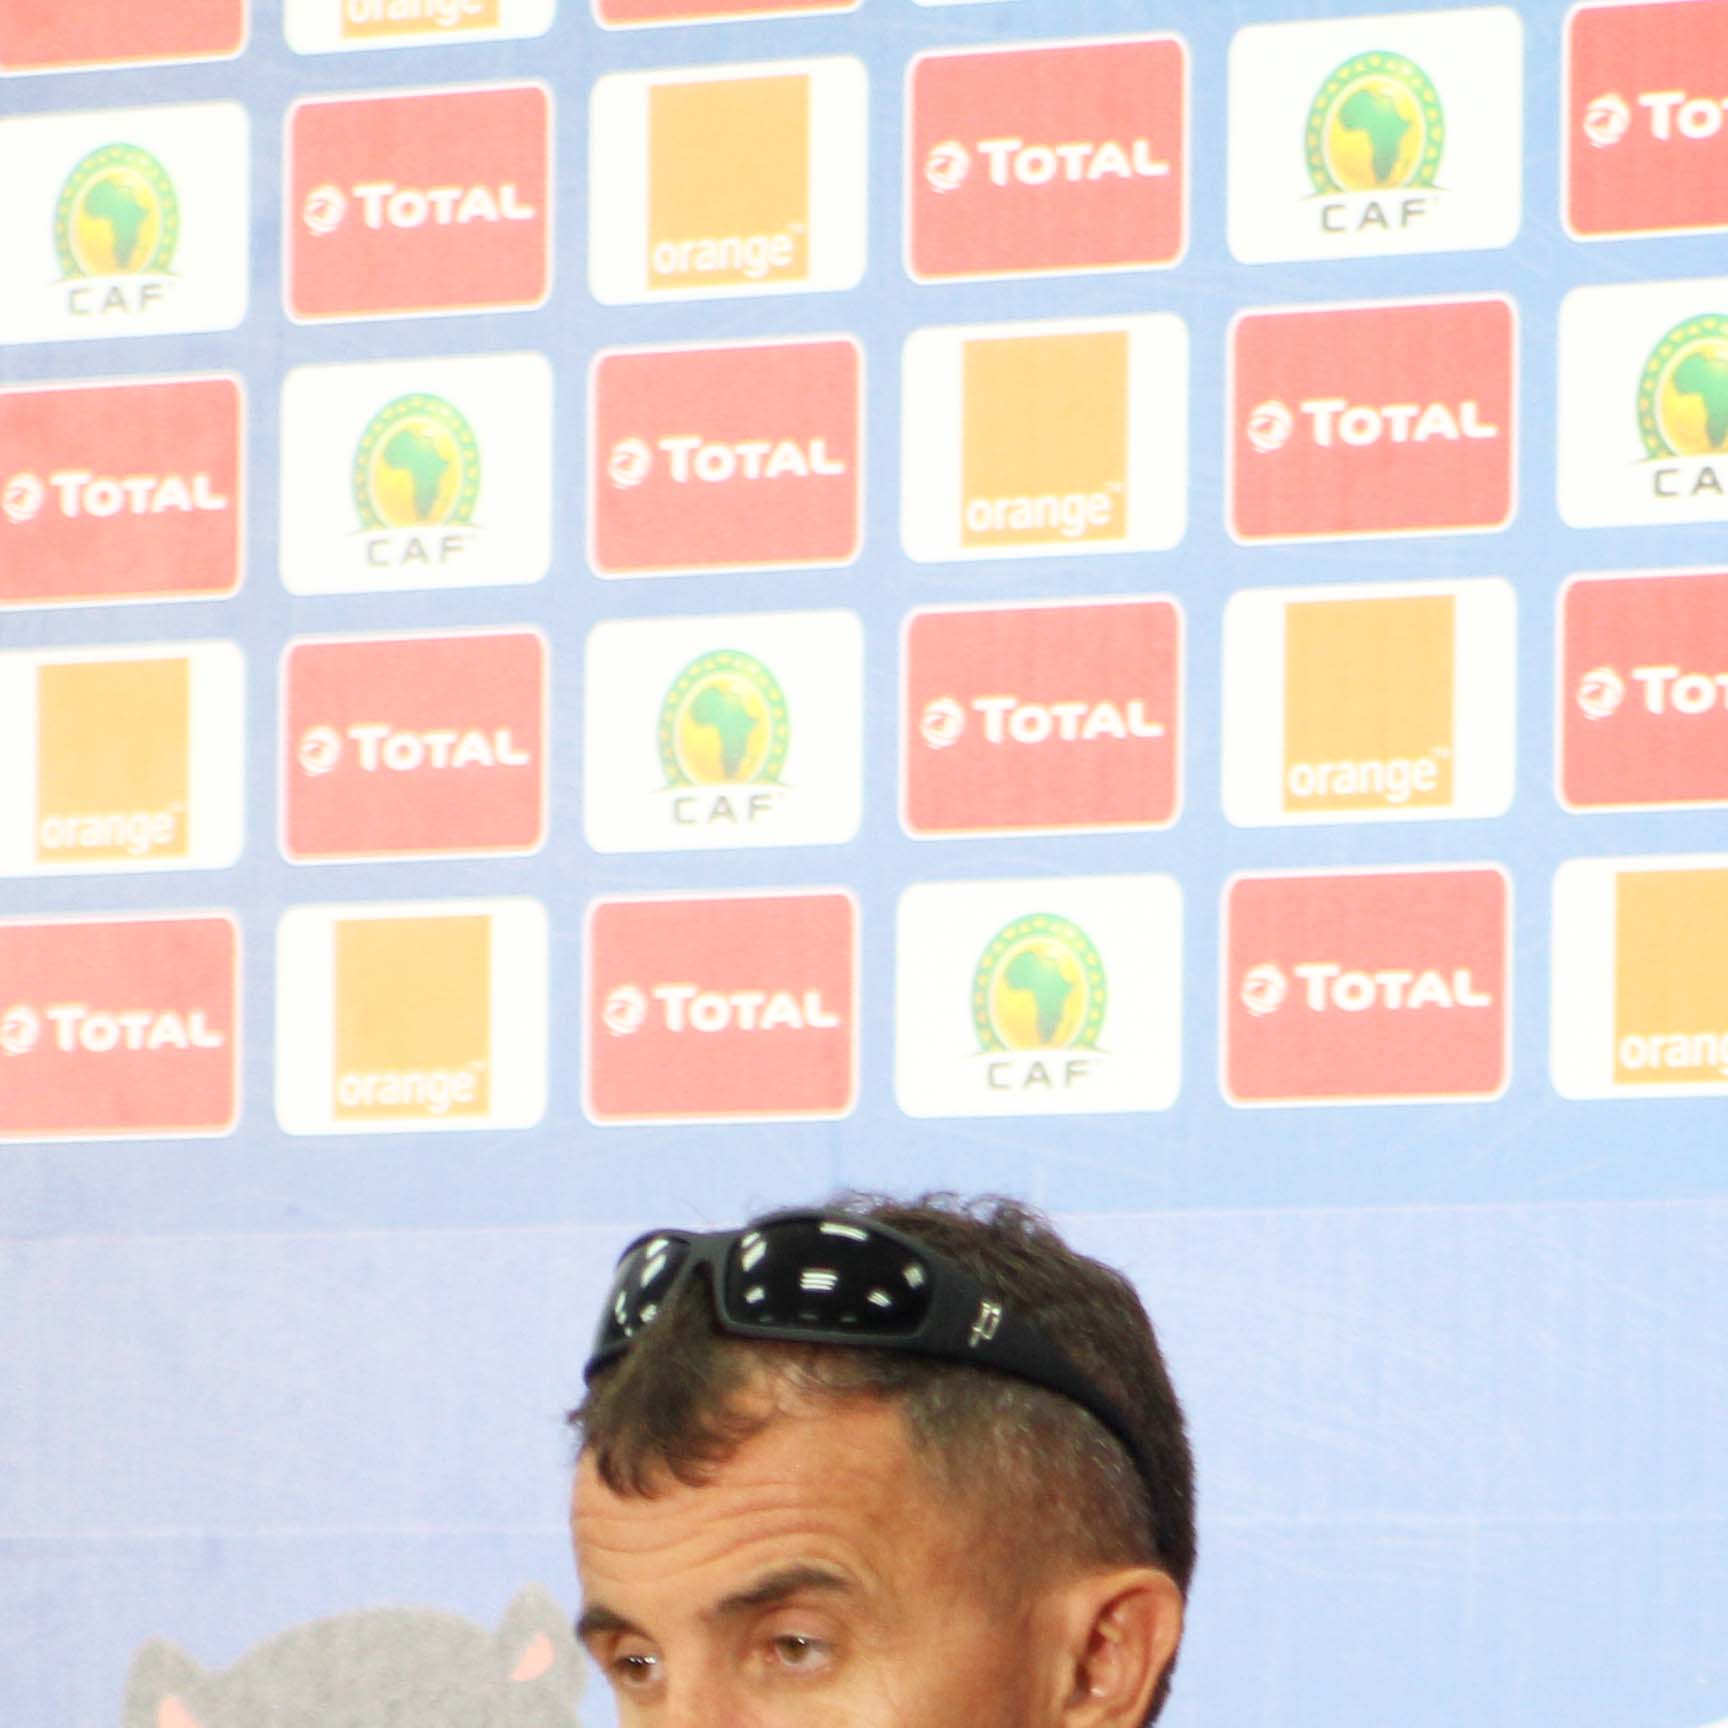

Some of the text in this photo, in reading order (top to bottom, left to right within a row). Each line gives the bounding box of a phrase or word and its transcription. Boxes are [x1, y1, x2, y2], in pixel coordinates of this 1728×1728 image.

[977, 137, 1169, 186] TOTAL
[352, 181, 535, 229] TOTAL
[1321, 198, 1426, 235] CAF
[651, 229, 793, 278] orange
[68, 283, 164, 317] CAF
[1300, 397, 1498, 447] TOTAL
[658, 434, 845, 483] TOTAL
[46, 469, 227, 517] TOTAL
[964, 485, 1112, 534] orange
[367, 535, 465, 569] CAF
[971, 695, 1164, 744] TOTAL
[347, 723, 530, 771] TOTAL
[1288, 754, 1438, 804] orange
[39, 805, 175, 856] orange
[673, 793, 773, 827] CAF
[652, 983, 840, 1032] TOTAL
[1294, 962, 1492, 1012] TOTAL
[45, 1003, 223, 1052] TOTAL
[338, 1065, 474, 1113] orange
[987, 1059, 1089, 1091] CAF
